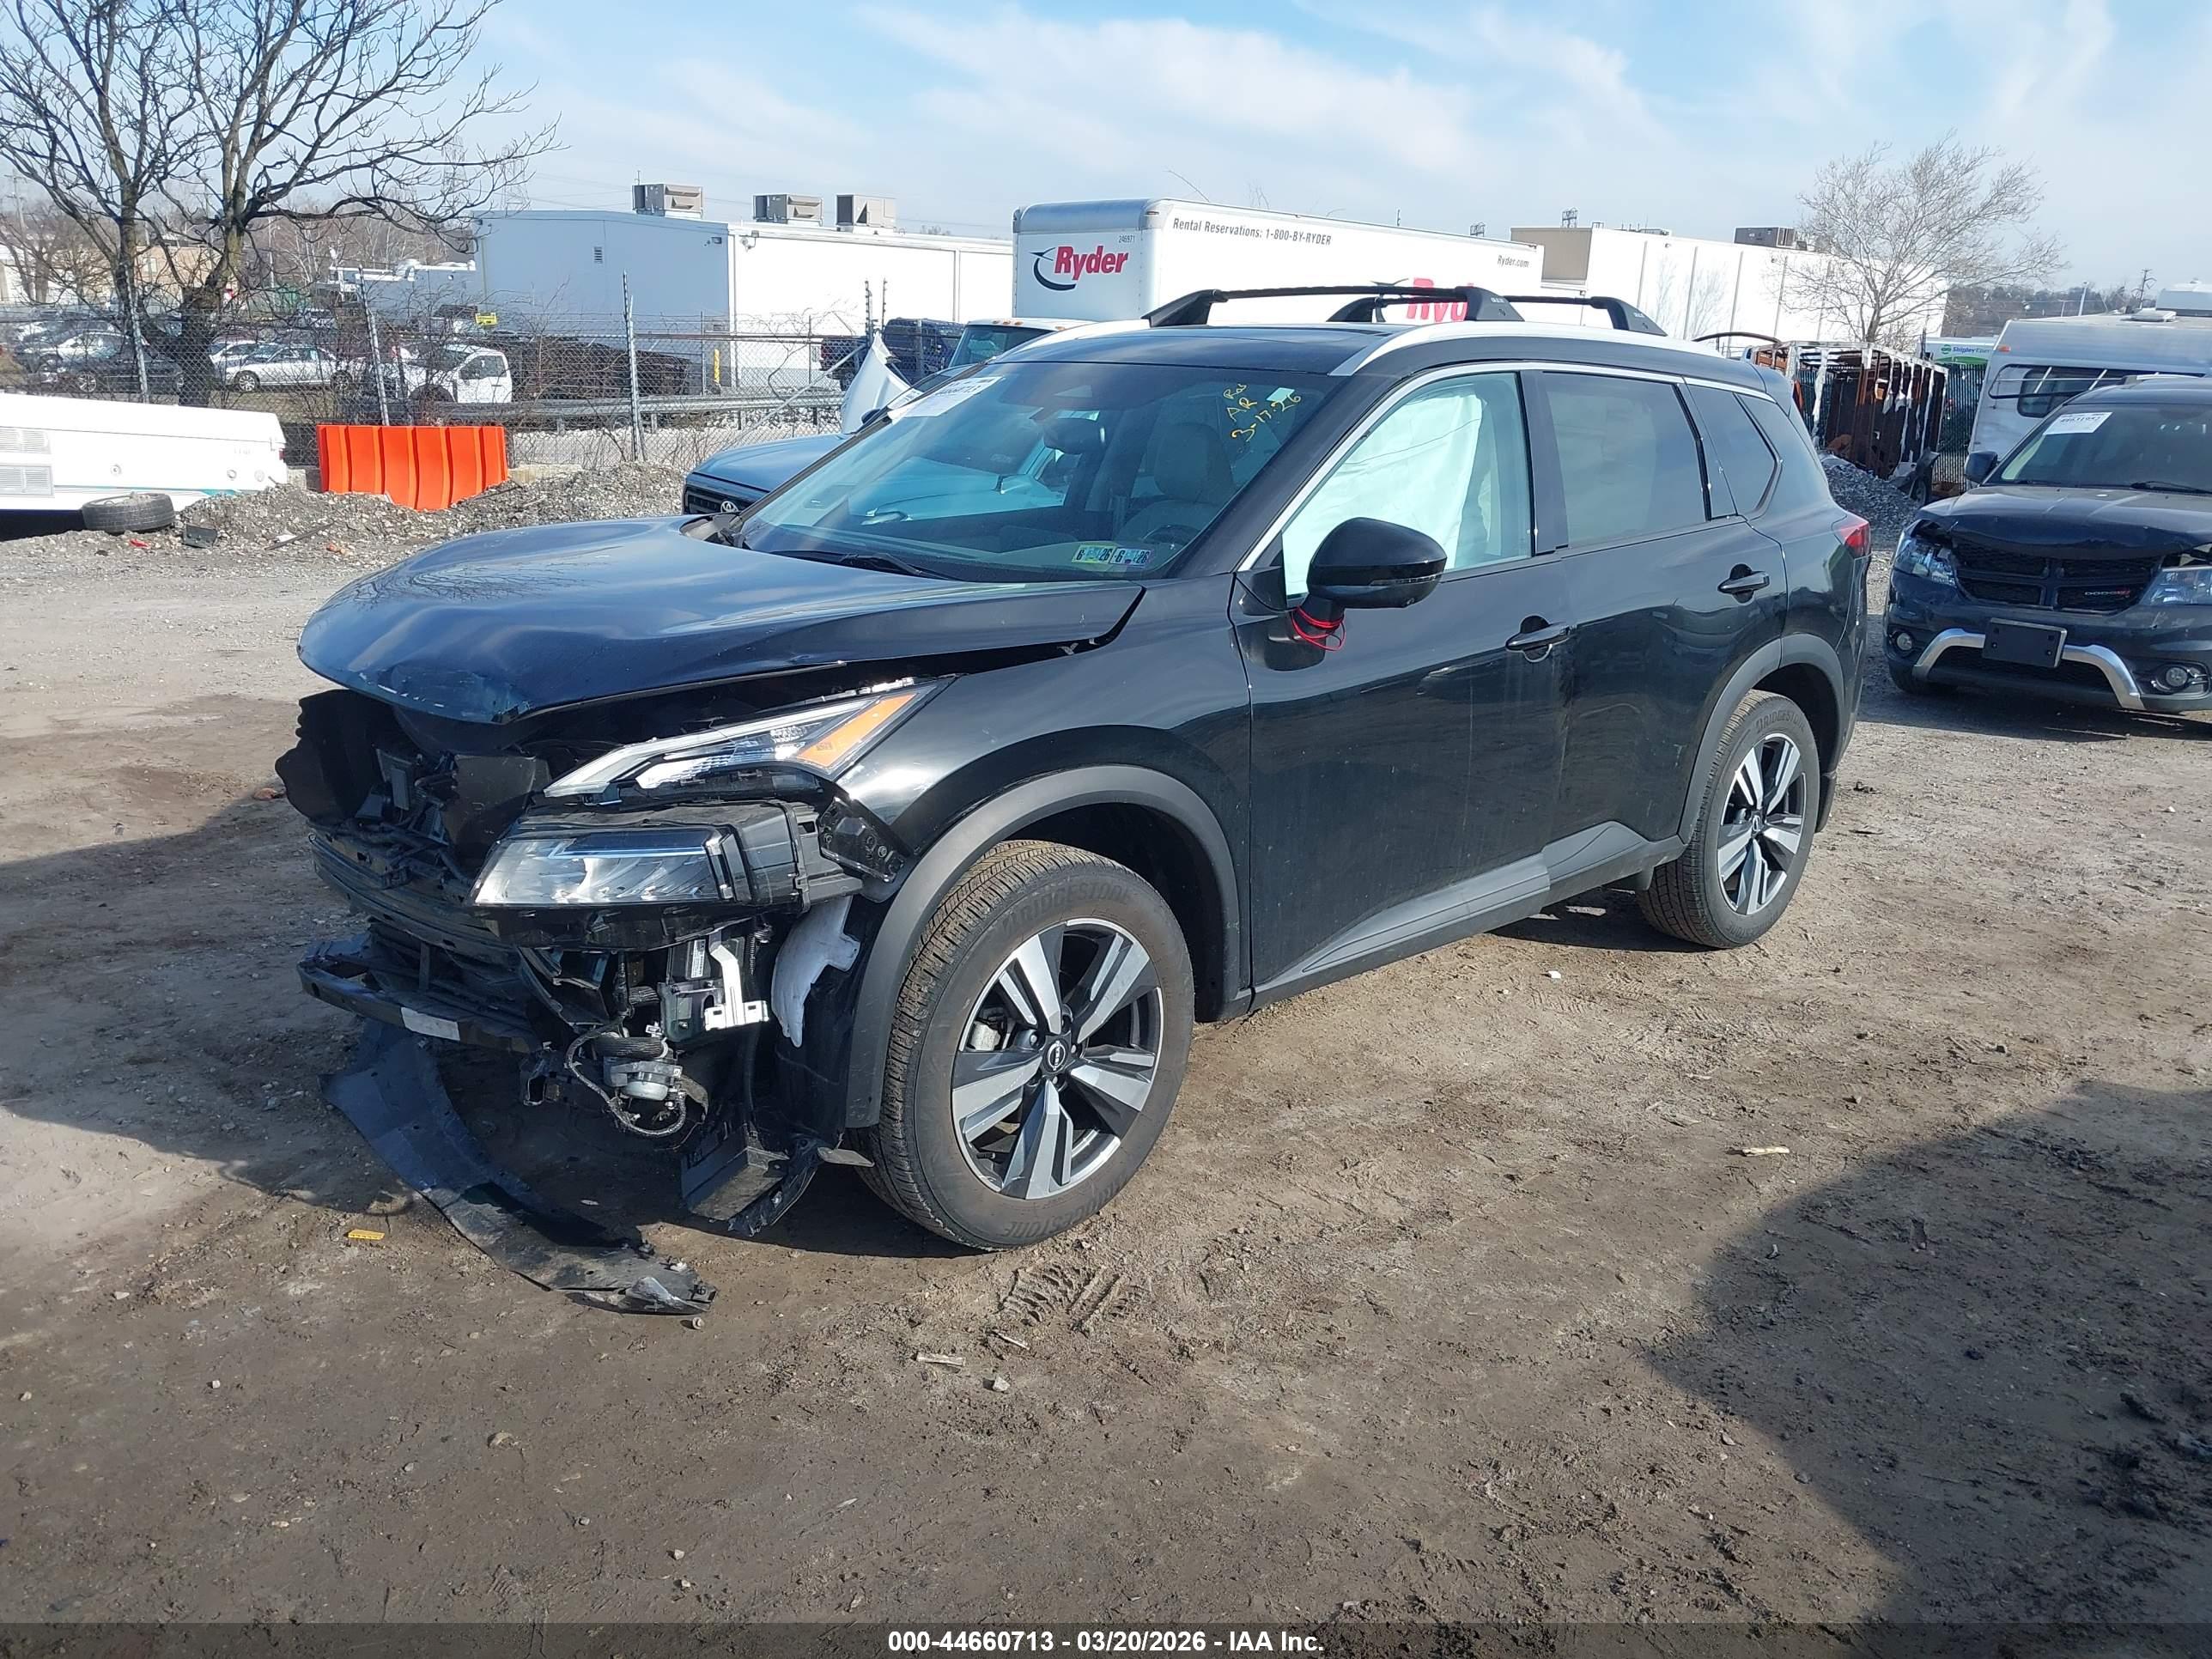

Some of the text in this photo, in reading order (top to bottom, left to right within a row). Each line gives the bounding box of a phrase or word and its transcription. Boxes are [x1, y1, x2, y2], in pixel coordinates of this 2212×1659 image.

[1173, 217, 1332, 246] Rental Reservations: 1-800-BY-RYDER
[1054, 245, 1129, 281] Ryder
[1497, 254, 1530, 268] Ryder.com
